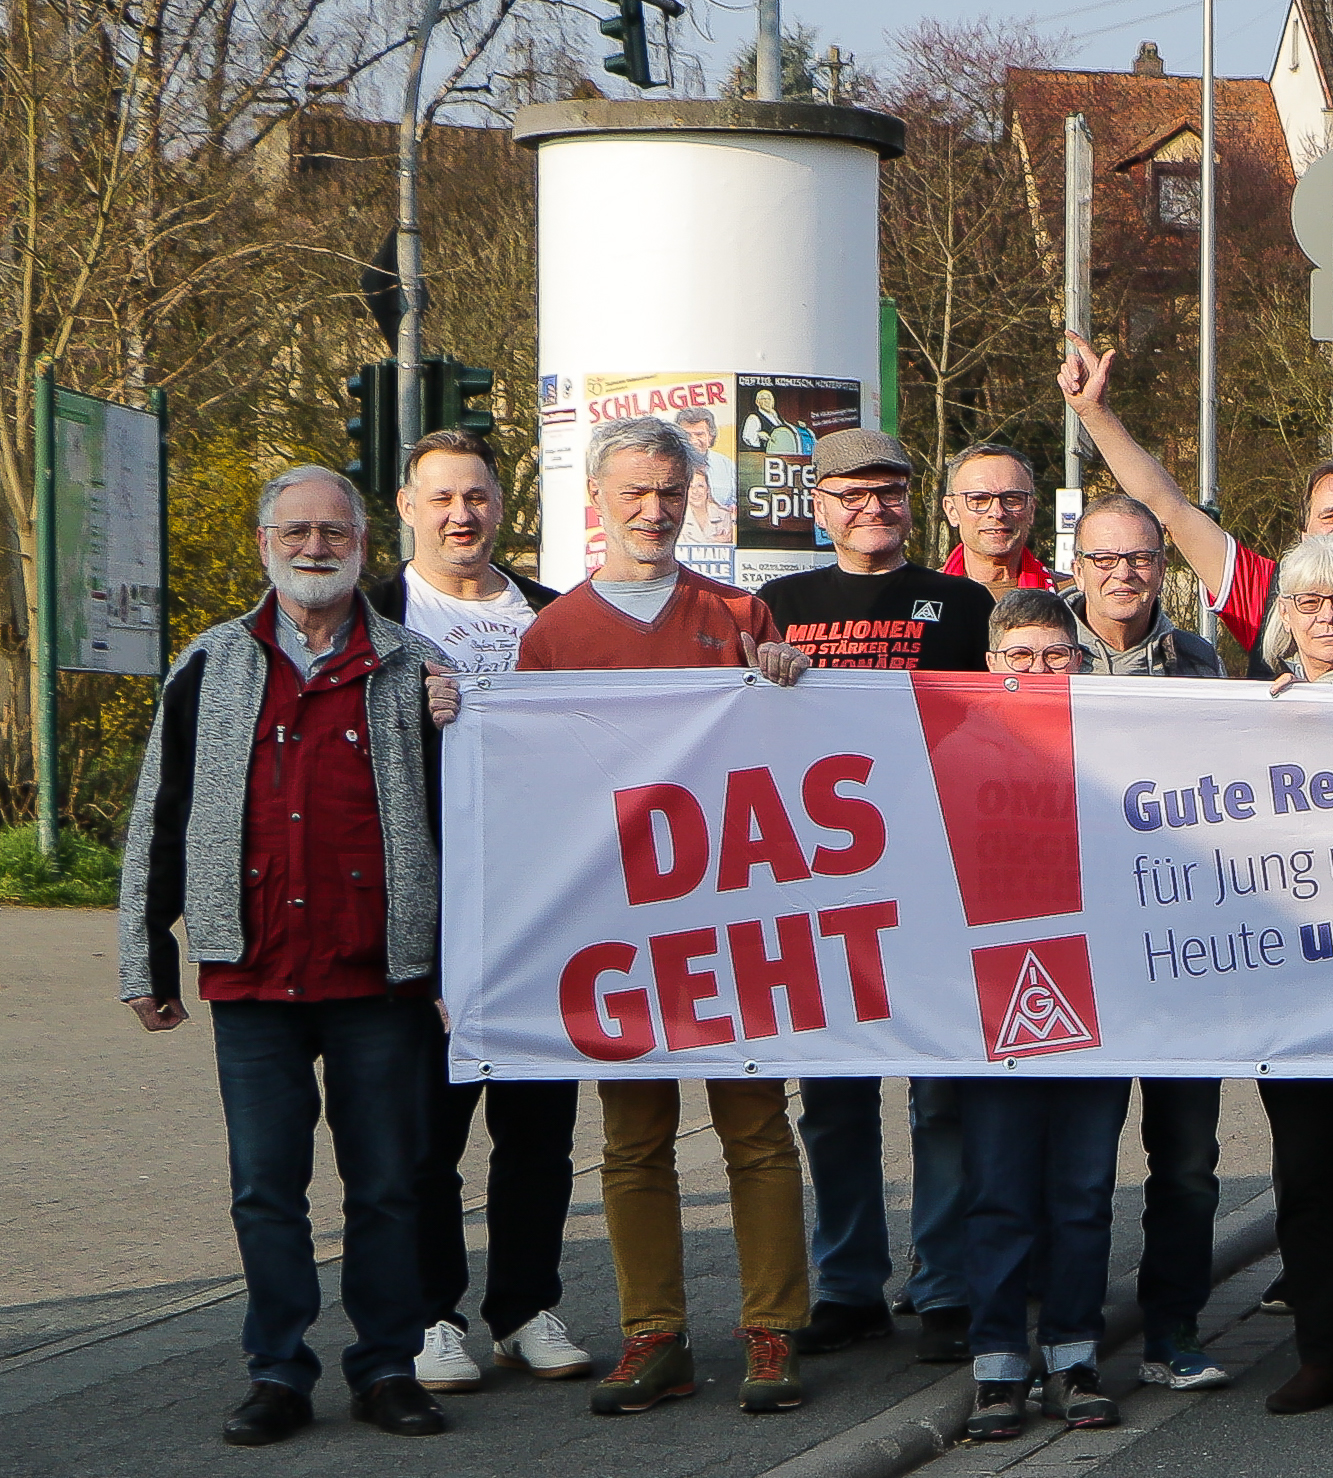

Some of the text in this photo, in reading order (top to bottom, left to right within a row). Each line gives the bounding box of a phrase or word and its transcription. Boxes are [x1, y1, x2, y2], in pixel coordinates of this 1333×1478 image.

[588, 381, 727, 423] SCHLAGER
[765, 457, 816, 488] Bre
[748, 486, 813, 527] Spit
[443, 625, 470, 646] THE
[470, 621, 518, 638] VINTA
[785, 620, 925, 643] MILLIONEN
[818, 640, 889, 656] STÄRKER
[891, 642, 922, 654] ALS
[1123, 775, 1256, 832] Gute
[612, 751, 887, 906] DAS
[1133, 853, 1197, 907] für
[1215, 847, 1320, 906] Jung
[1144, 922, 1286, 981] Heute
[559, 900, 900, 1062] GEHT
